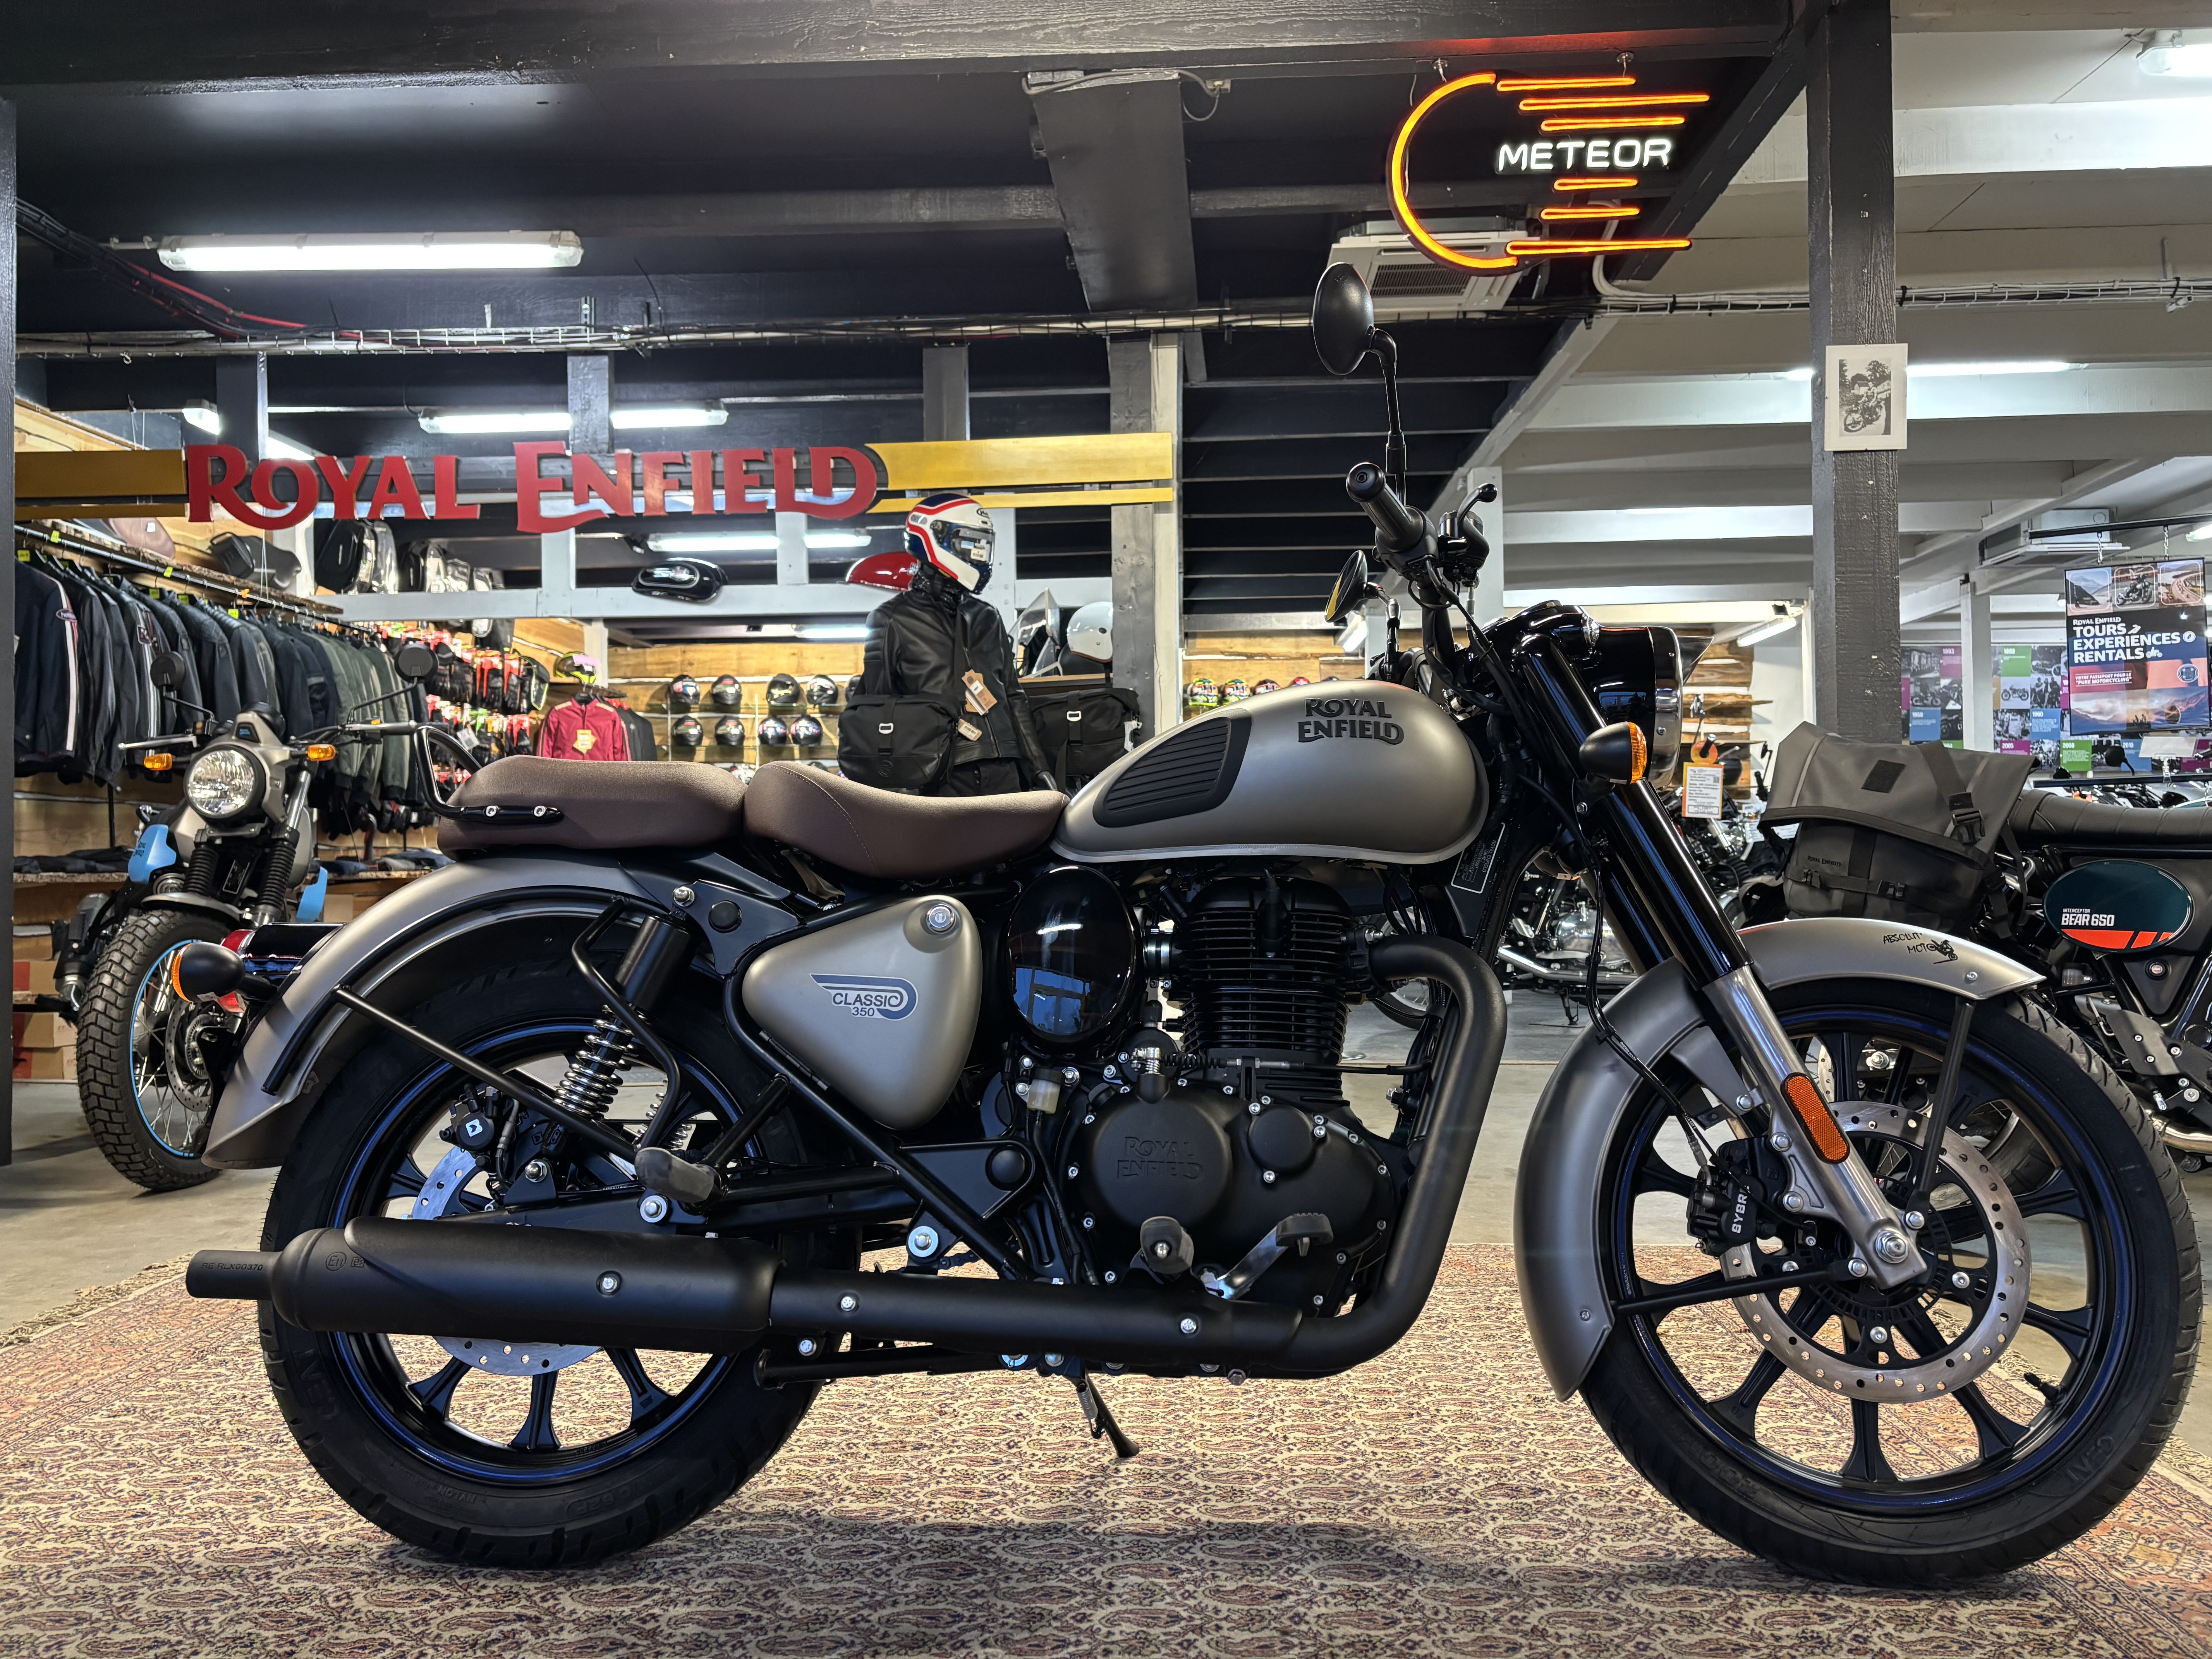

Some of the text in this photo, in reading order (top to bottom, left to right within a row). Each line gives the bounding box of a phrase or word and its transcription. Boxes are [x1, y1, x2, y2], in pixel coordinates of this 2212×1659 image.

[1497, 138, 1672, 171] METEOR
[187, 441, 878, 533] ROYAL ENFIELD
[2073, 623, 2126, 638] TOURS
[2073, 632, 2181, 651] EXPERIENCES
[2074, 647, 2145, 663] RENTALS
[1305, 698, 1392, 719] ROYAL
[1297, 719, 1404, 745] ENFIELD
[2061, 913, 2115, 927] BEAR 650
[832, 992, 904, 1008] CLASSIC
[852, 1008, 875, 1017] 350
[1124, 1137, 1195, 1158] ROYAL
[1116, 1159, 1204, 1180] ENFIELD
